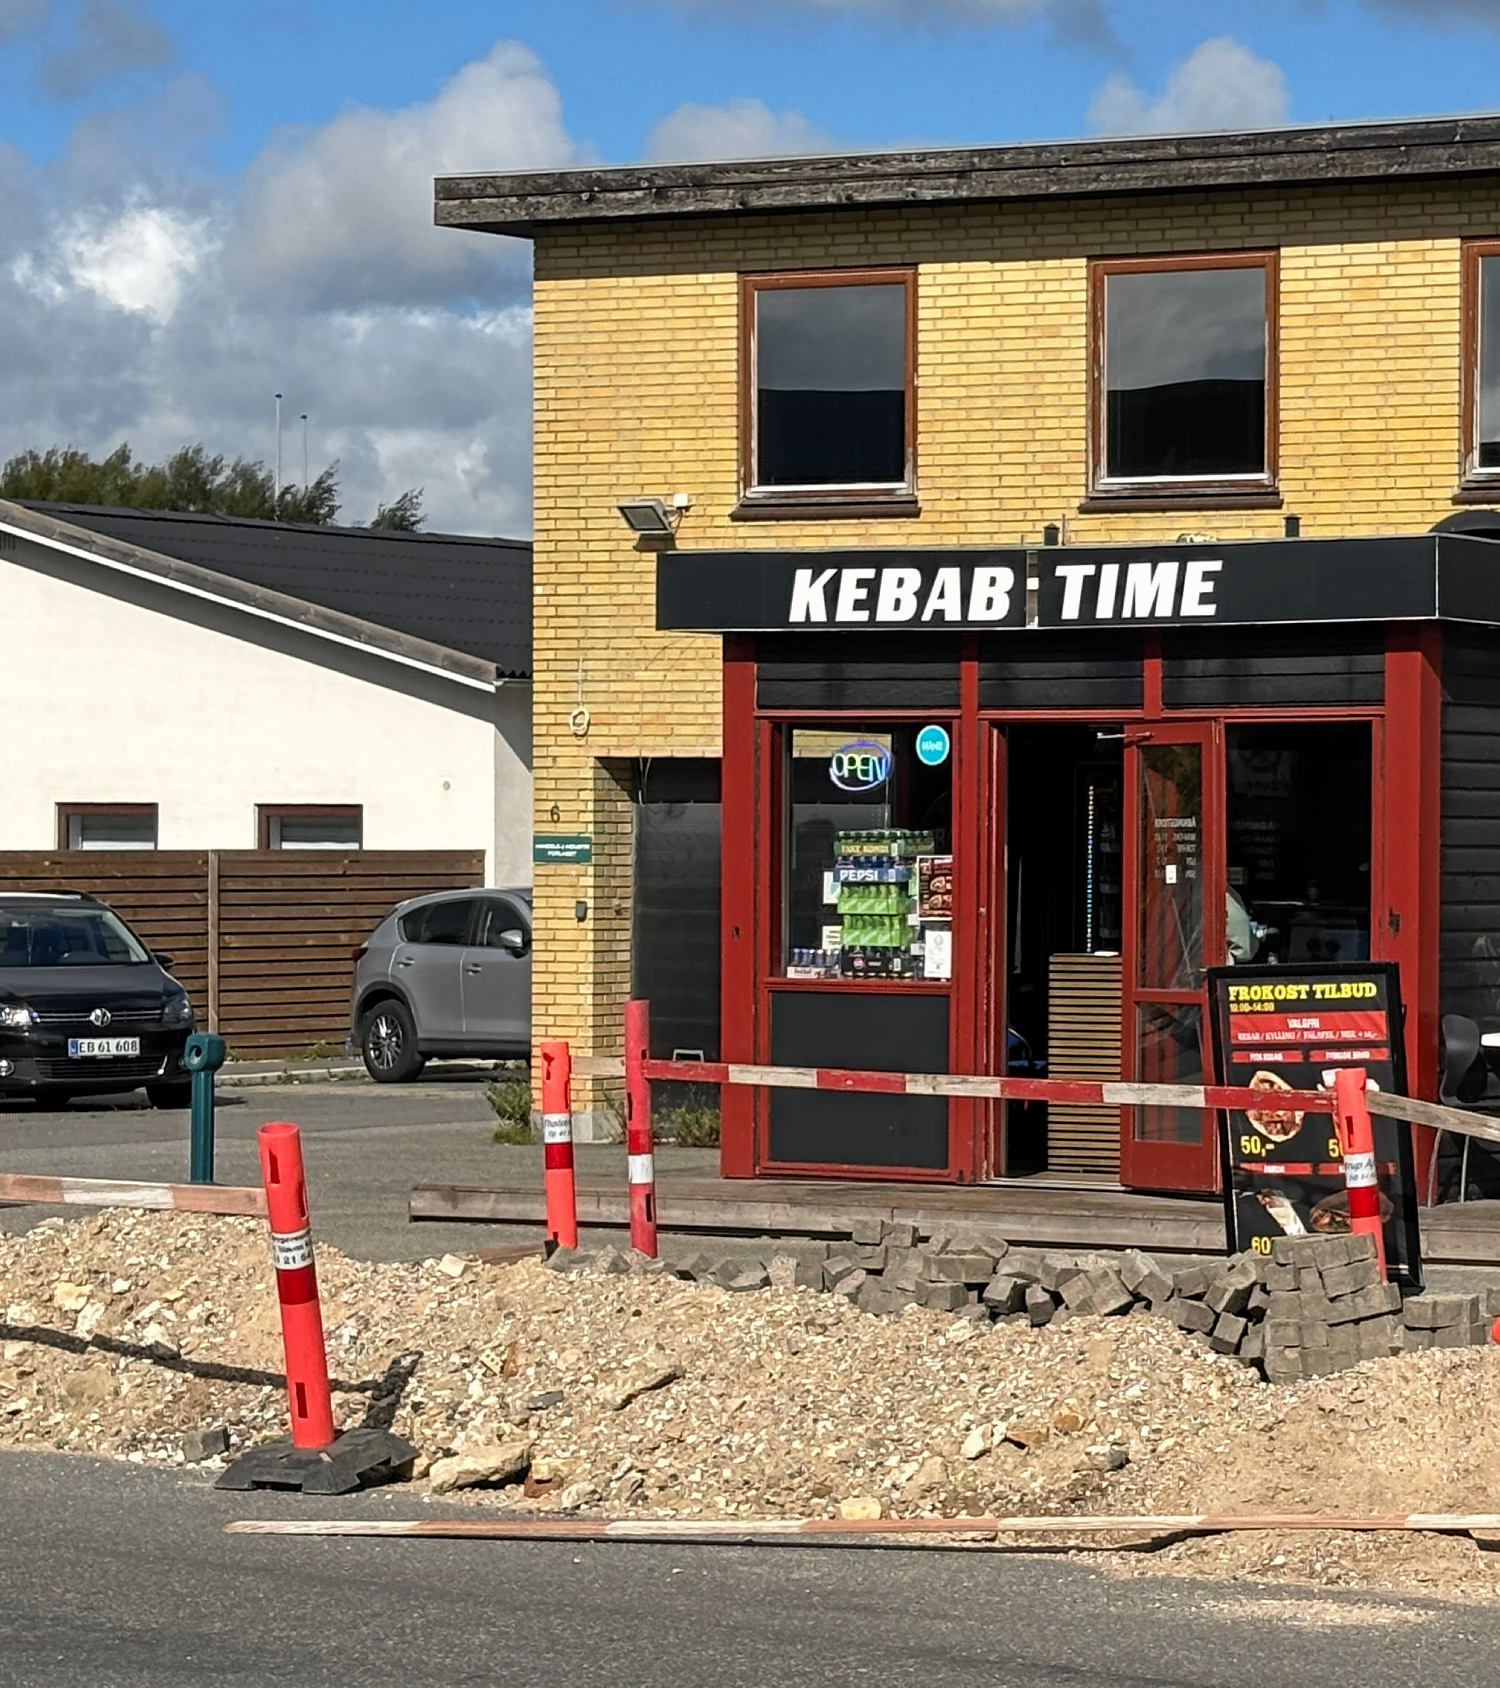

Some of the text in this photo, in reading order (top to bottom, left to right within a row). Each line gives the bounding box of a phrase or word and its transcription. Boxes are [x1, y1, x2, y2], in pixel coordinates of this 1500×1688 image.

[788, 560, 1223, 622] KEBAB TIME
[832, 753, 886, 782] OPEN
[550, 805, 561, 824] 6
[840, 869, 878, 881] PEPSI
[1228, 982, 1377, 1001] FROKOST TILBUD
[79, 1040, 138, 1053] EB 61 608
[1240, 1135, 1275, 1157] 50,-
